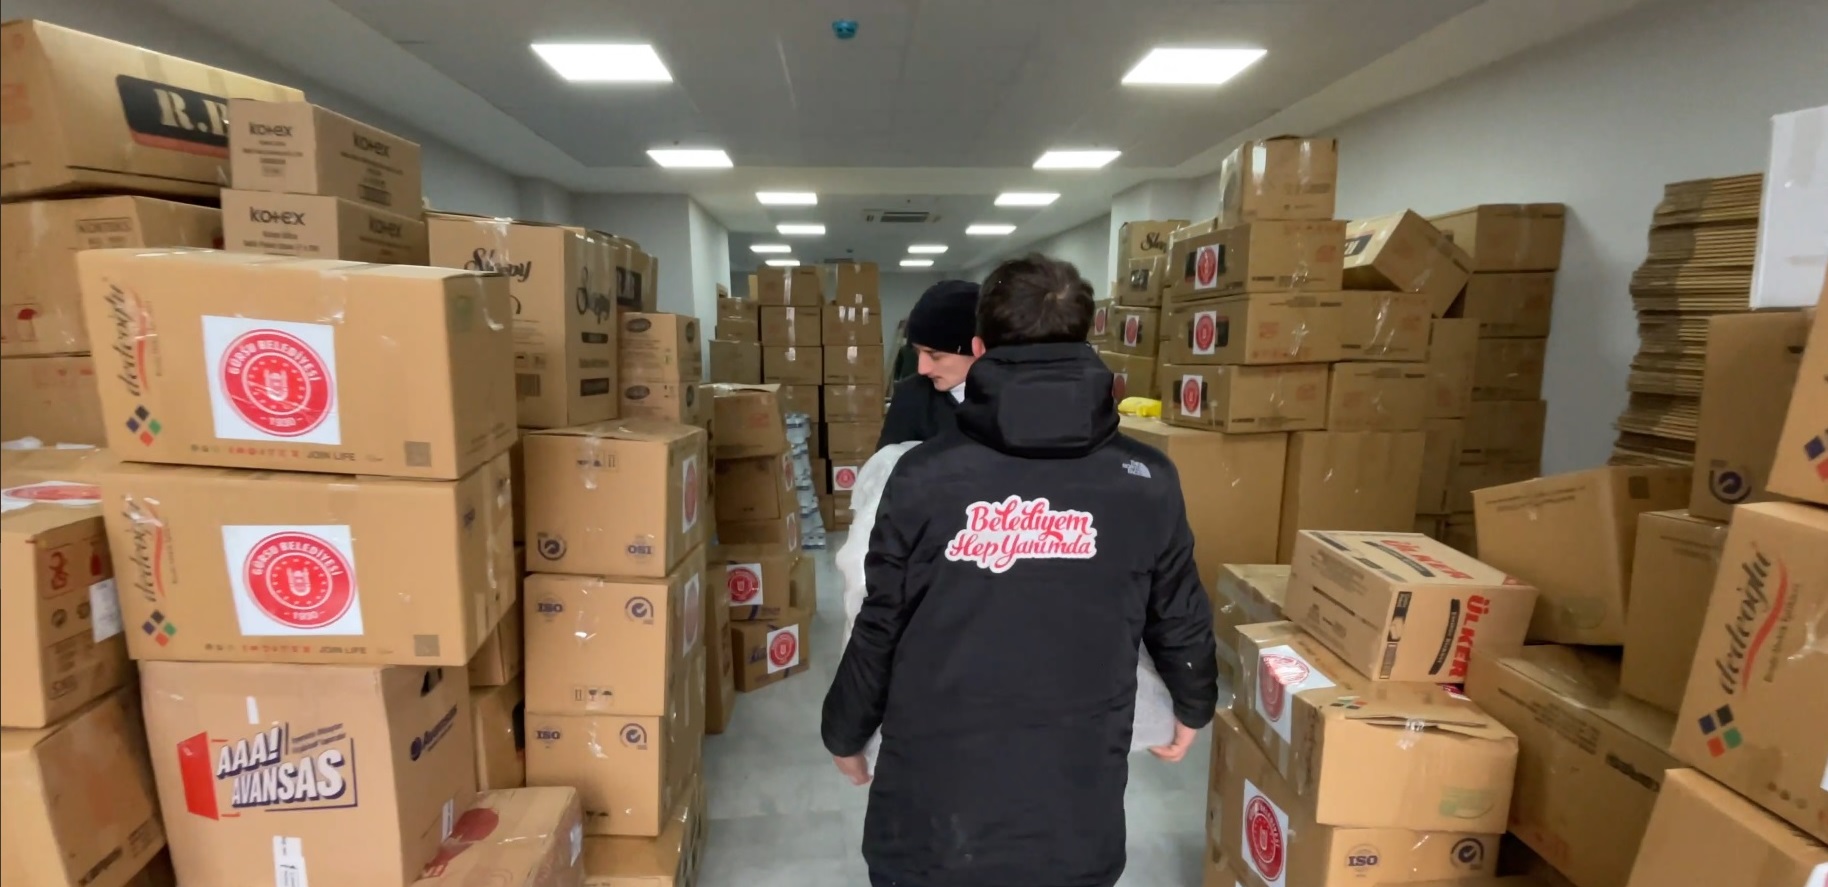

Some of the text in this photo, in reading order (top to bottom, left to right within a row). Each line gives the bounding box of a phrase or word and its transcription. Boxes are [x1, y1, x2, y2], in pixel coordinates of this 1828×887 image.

[249, 122, 293, 138] kotex
[250, 207, 306, 226] kotex
[257, 339, 322, 381] BELEDİYESİ
[334, 452, 356, 461] LIFE
[971, 499, 1092, 542] Belediyem
[250, 540, 344, 576] GÜRSU BELEDİYESİ
[950, 533, 1092, 569] Hep Yanımda
[537, 602, 564, 613] ISO
[1449, 594, 1491, 677] ÜLKER
[216, 725, 284, 780] AAA!
[536, 730, 561, 740] ISO
[232, 748, 347, 809] AVANSAS
[1348, 855, 1378, 867] ISO
